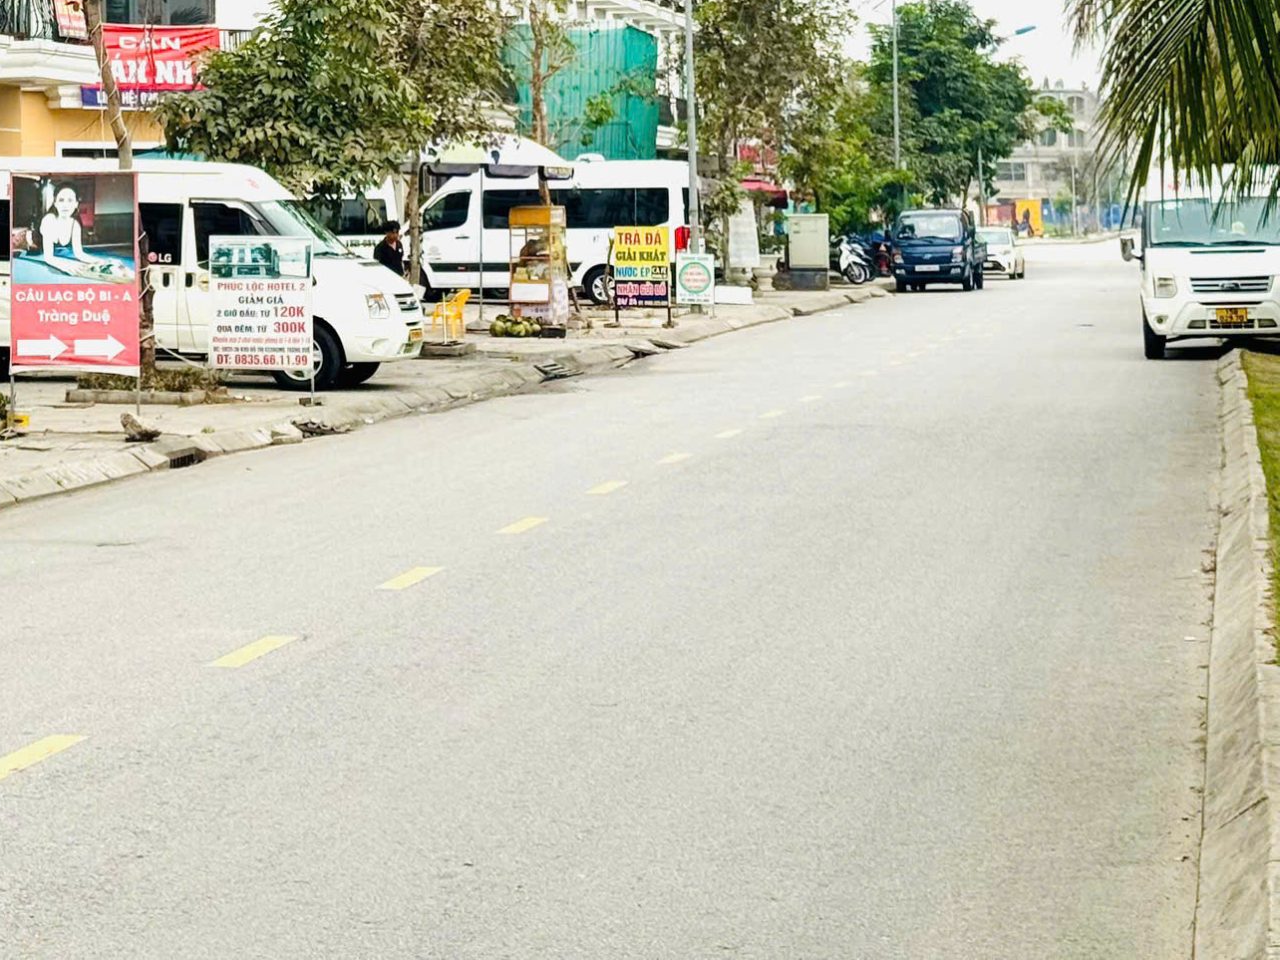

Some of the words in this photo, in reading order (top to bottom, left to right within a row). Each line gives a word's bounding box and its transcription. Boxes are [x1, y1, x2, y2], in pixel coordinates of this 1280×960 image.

[617, 230, 642, 246] TRÀ
[645, 230, 663, 246] ĐÁ
[158, 253, 173, 263] LG
[267, 282, 297, 292] HOTEL
[299, 282, 306, 292] 2
[16, 288, 44, 303] CÂU
[48, 290, 74, 305] LẠC
[77, 288, 96, 305] BỘ
[100, 291, 112, 302] BI
[122, 290, 133, 302] A
[82, 308, 111, 326] Duệ
[273, 306, 306, 318] 120K
[273, 321, 307, 334] 300K
